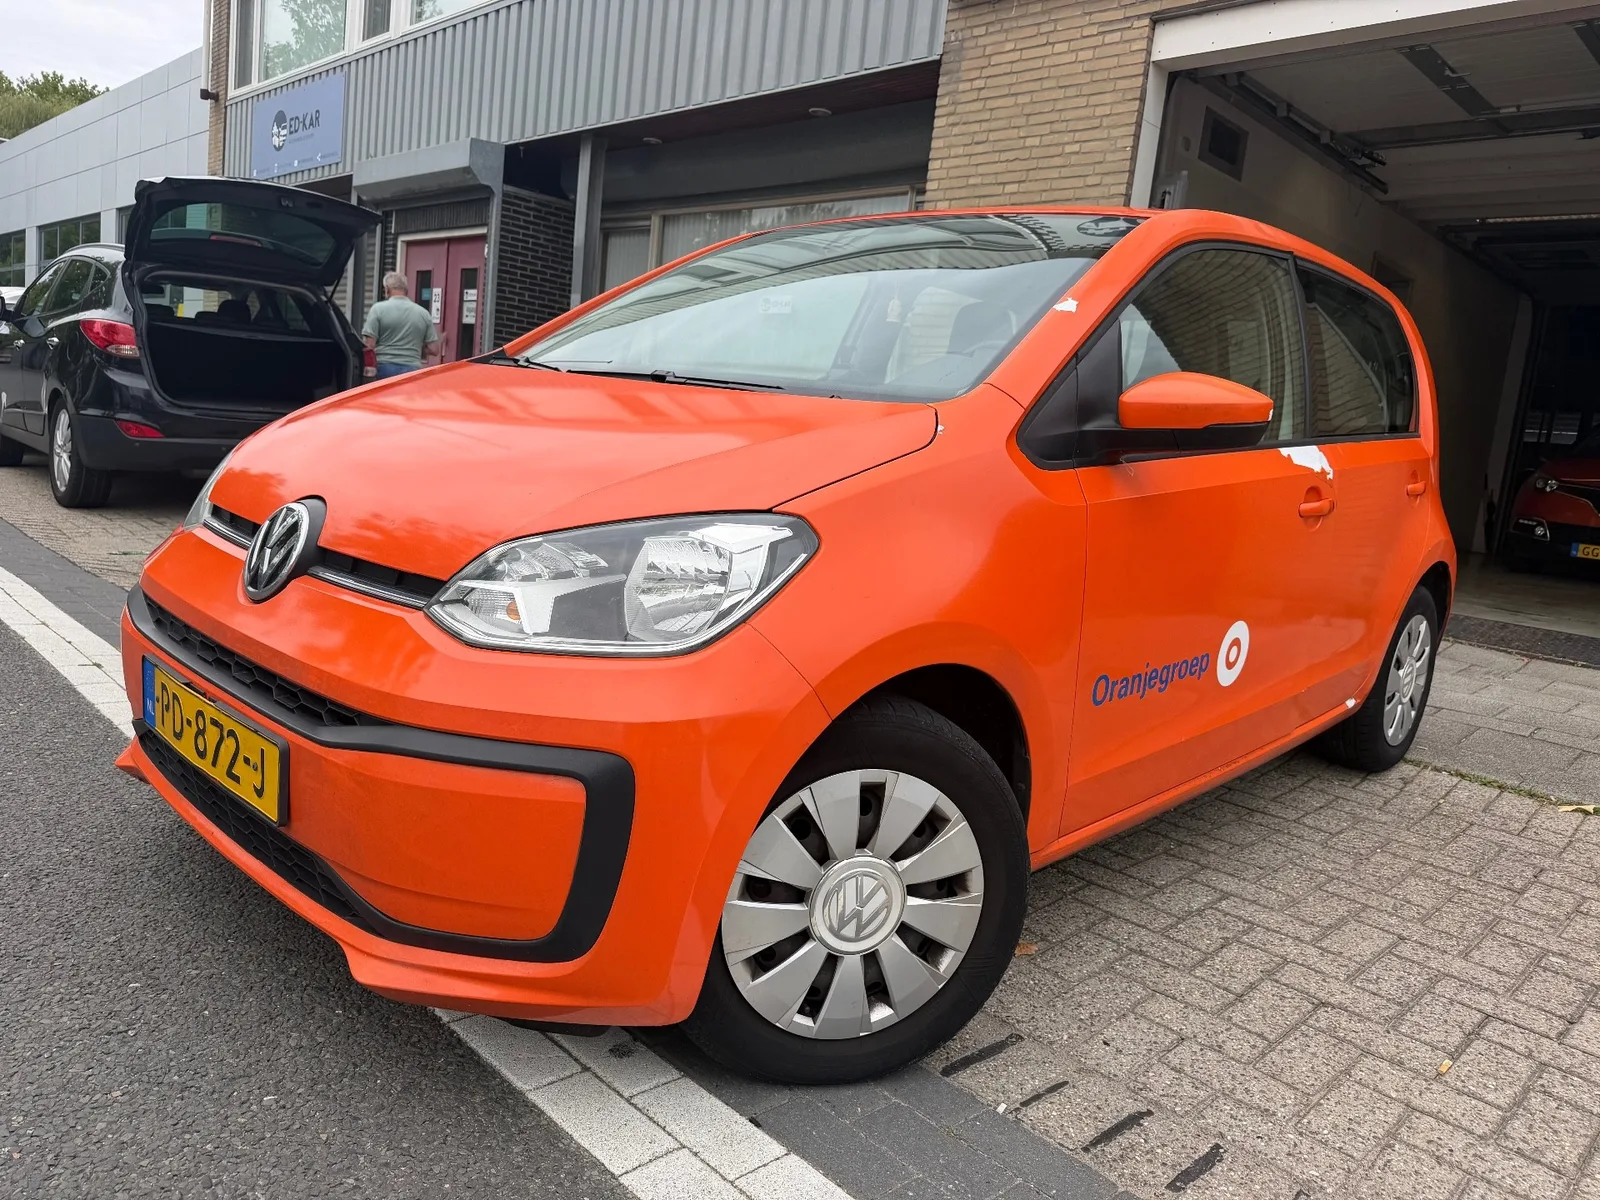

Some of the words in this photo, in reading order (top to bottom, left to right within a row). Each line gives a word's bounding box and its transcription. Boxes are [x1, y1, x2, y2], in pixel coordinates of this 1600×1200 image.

[146, 697, 155, 716] NL
[1092, 652, 1210, 707] Oranjegroep
[160, 681, 265, 799] PD-872-J
